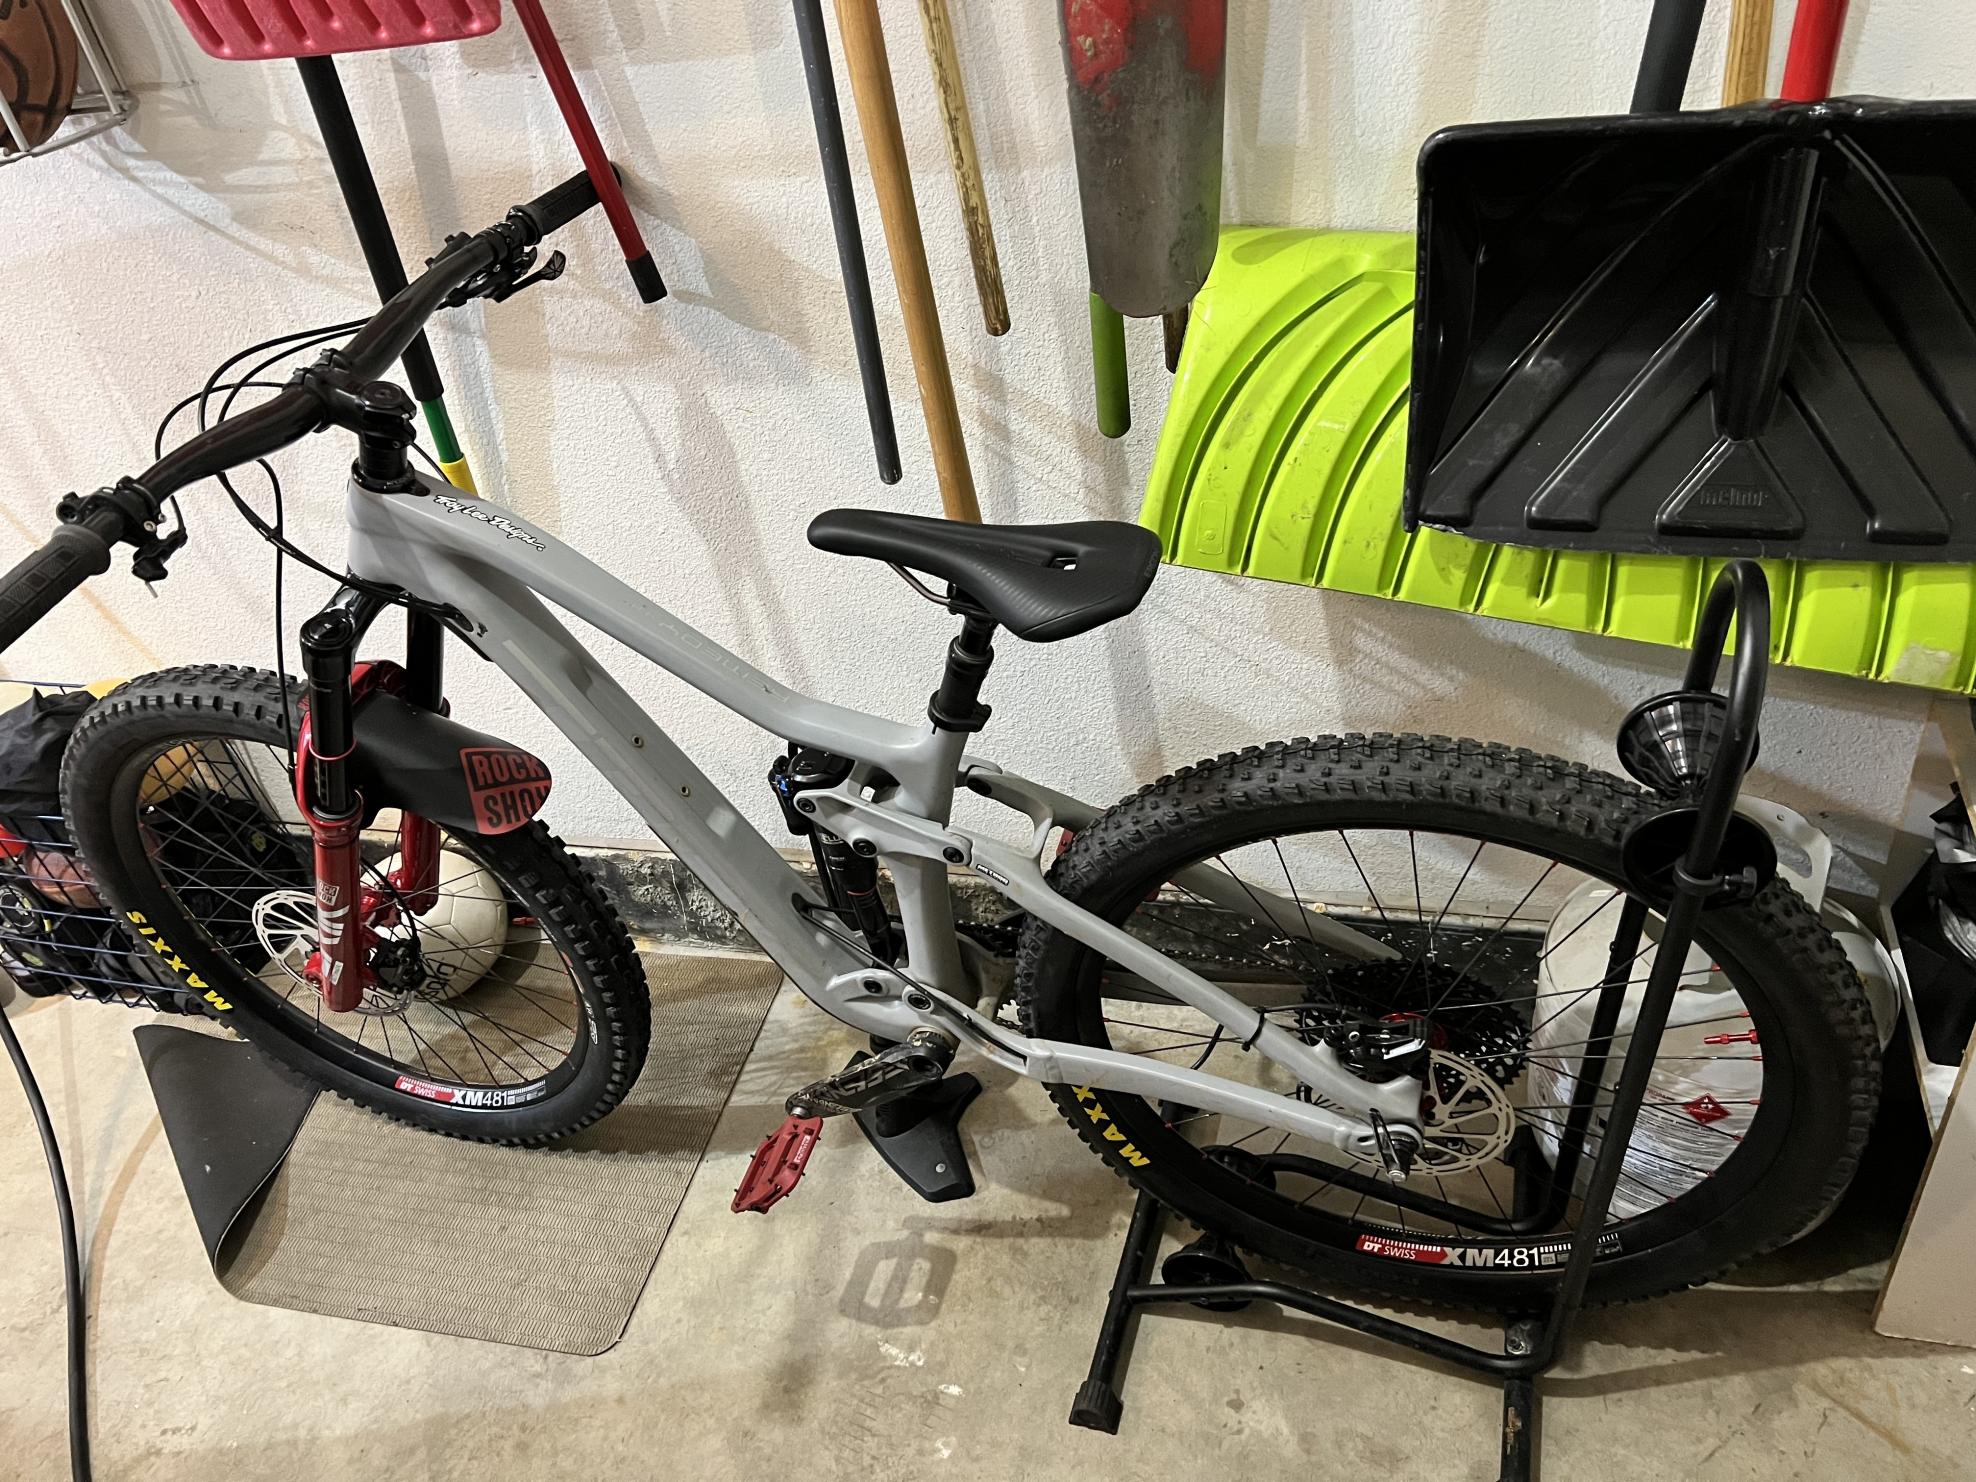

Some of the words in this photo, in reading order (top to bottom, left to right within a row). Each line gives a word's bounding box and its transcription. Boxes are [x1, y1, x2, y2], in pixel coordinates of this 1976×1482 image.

[433, 494, 466, 513] Troy
[460, 505, 490, 522] Lee
[471, 754, 545, 785] ROCK
[126, 911, 233, 1011] MAXXIS
[400, 1083, 413, 1092] DT
[413, 1086, 436, 1099] SWISS
[451, 1089, 509, 1107] XM481
[1362, 1241, 1382, 1253] DT
[1383, 1245, 1417, 1260] SWISS
[1440, 1246, 1541, 1268] XM481
